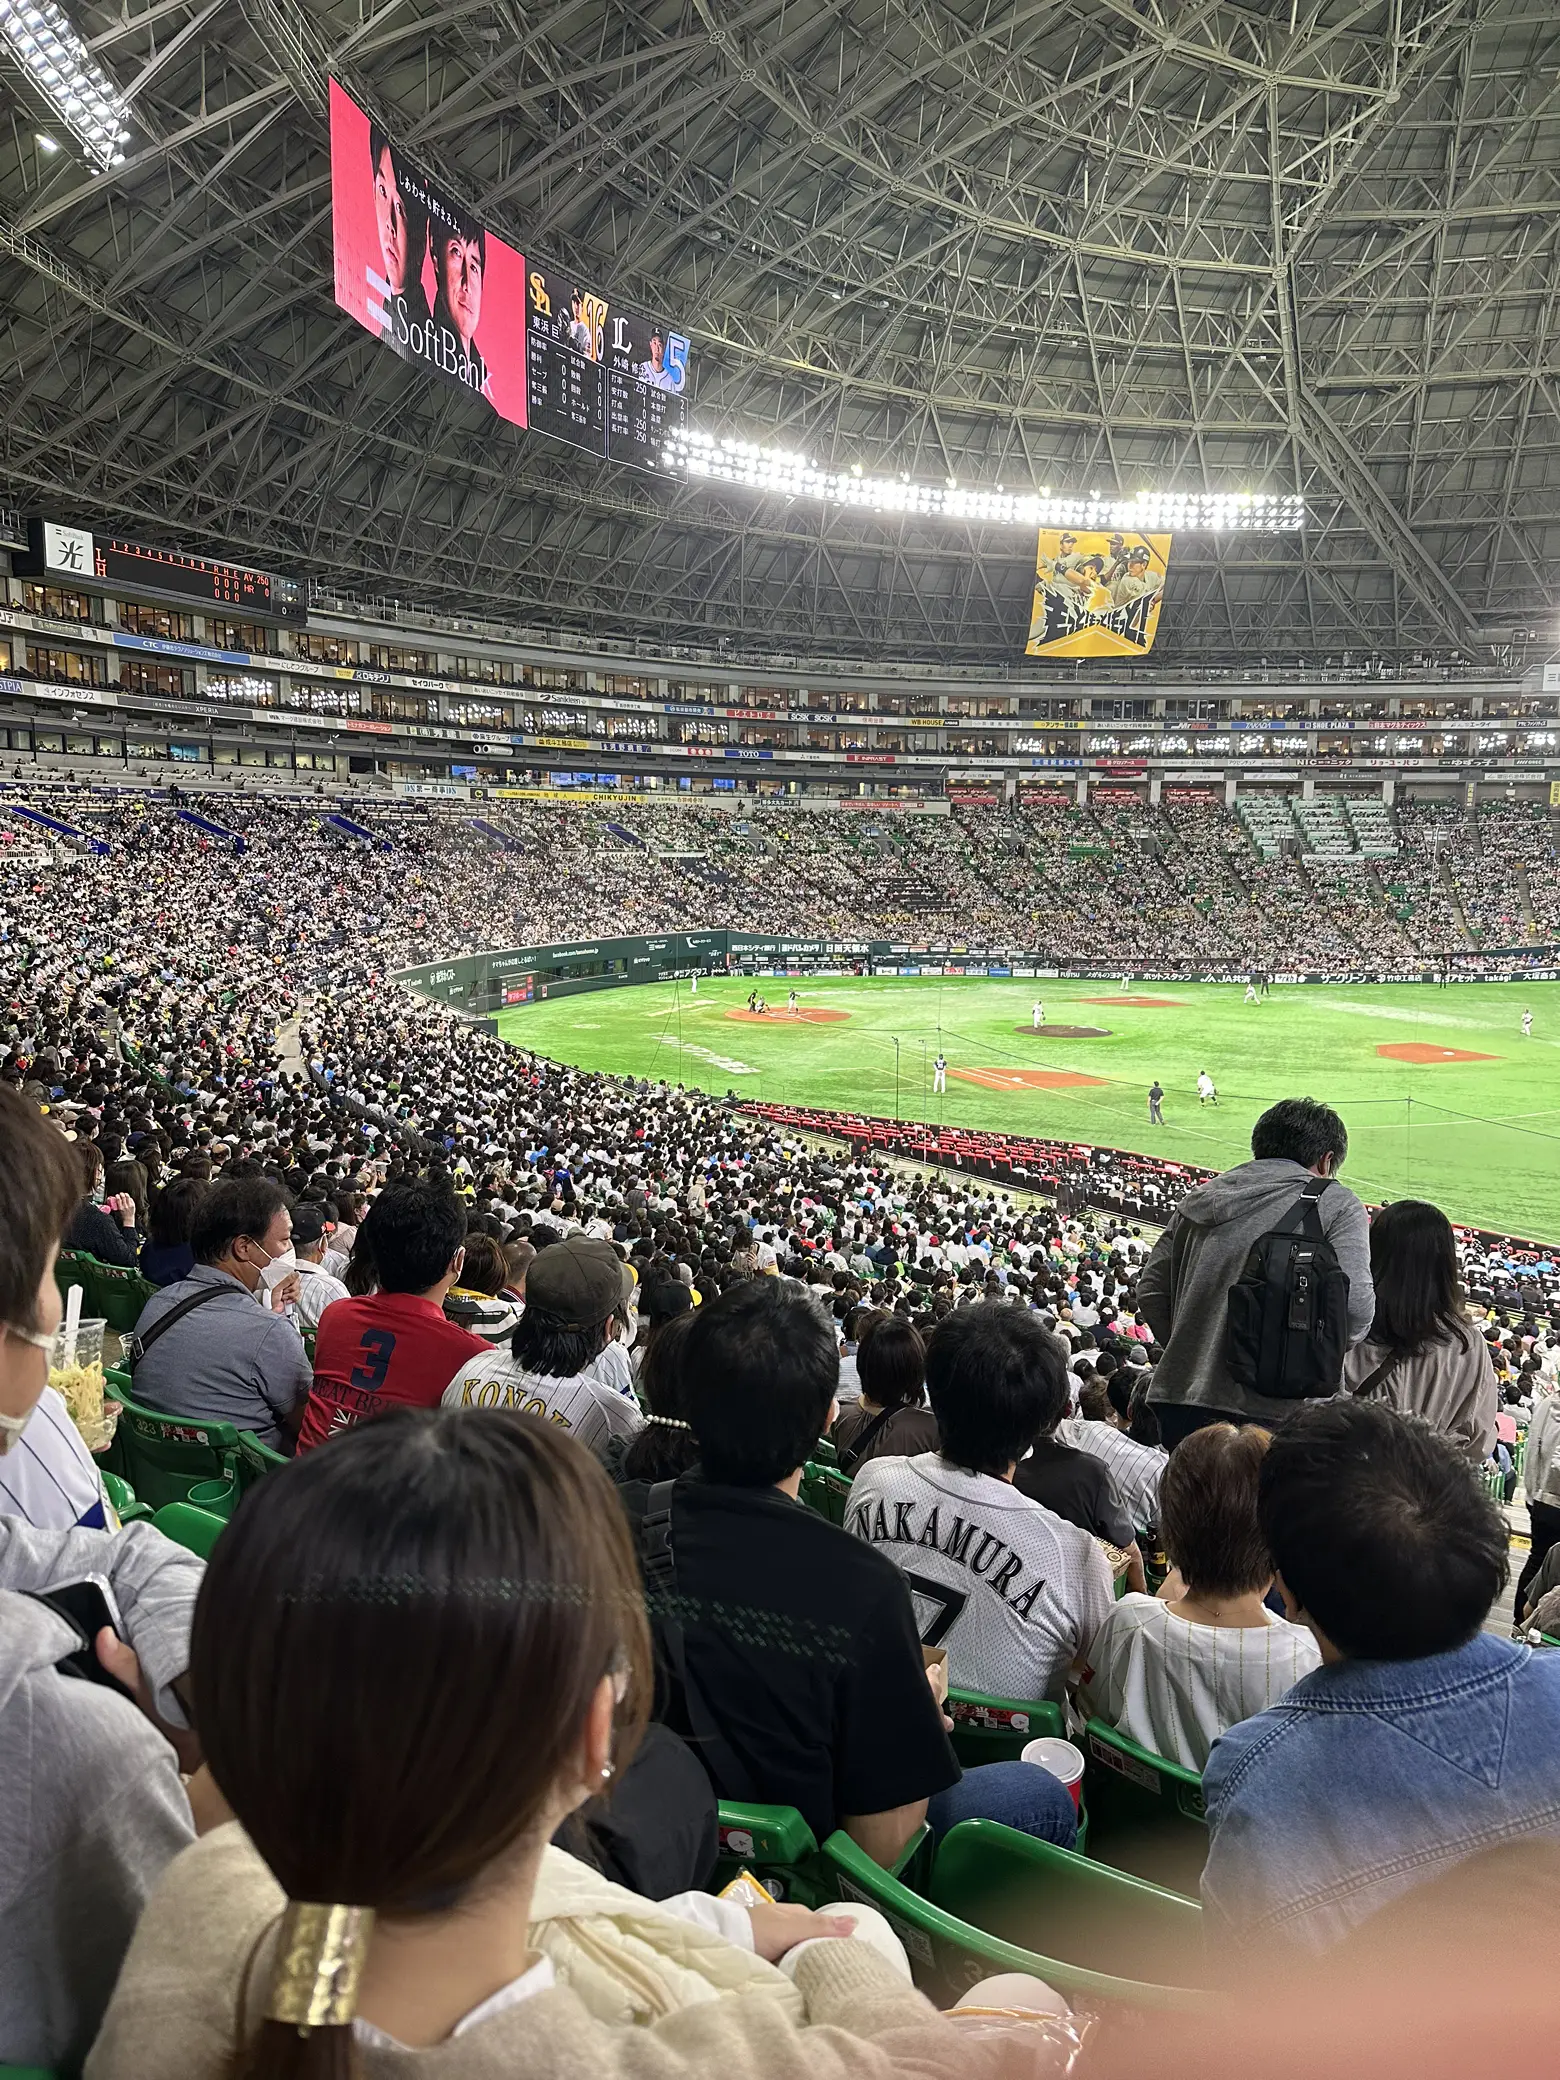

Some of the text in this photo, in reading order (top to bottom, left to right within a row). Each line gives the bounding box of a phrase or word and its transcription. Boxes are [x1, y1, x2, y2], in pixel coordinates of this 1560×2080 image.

[399, 169, 461, 234] しあわせも貯まるよ。
[532, 315, 560, 339] 東浜 巨
[587, 298, 605, 361] 16
[397, 297, 495, 399] SoftBank
[669, 335, 686, 392] 5
[562, 364, 567, 376] 0
[531, 366, 548, 380] セーブ
[562, 379, 567, 390] 0
[611, 374, 623, 385] 打率
[633, 381, 647, 396] .250
[562, 393, 567, 404] 0
[611, 387, 629, 399] 安打数
[680, 411, 685, 421] 0
[611, 399, 623, 410] 打点
[642, 409, 647, 419] 0
[633, 418, 647, 431] .250
[633, 430, 647, 443] .250
[57, 540, 84, 570] 光
[95, 547, 270, 597] L 0 0 0 HR 0
[96, 562, 240, 602] H 0 0 0
[142, 641, 159, 649] CTC
[51, 688, 95, 700] インフォセンス
[195, 706, 219, 715] XPERIA
[738, 750, 760, 758] TOTO
[593, 793, 637, 802] CHIKYUJIN
[731, 944, 777, 952] 西日本シティ銀行
[825, 944, 870, 953] 日田天領水
[1060, 971, 1080, 979] FUJITSU
[1085, 971, 1135, 979] メガネのヨネワ
[1142, 972, 1192, 981] ホットスタッフ
[1217, 974, 1252, 984] JA共済
[1320, 973, 1367, 984] サニクリーン
[1386, 974, 1422, 982] 竹中工務店
[1484, 973, 1512, 983] takagi
[1522, 971, 1558, 981] 大塚商会
[586, 1225, 596, 1236] 7
[350, 1328, 397, 1392] 3
[135, 1418, 157, 1435] 323
[857, 1499, 1047, 1621] NAKAMURA
